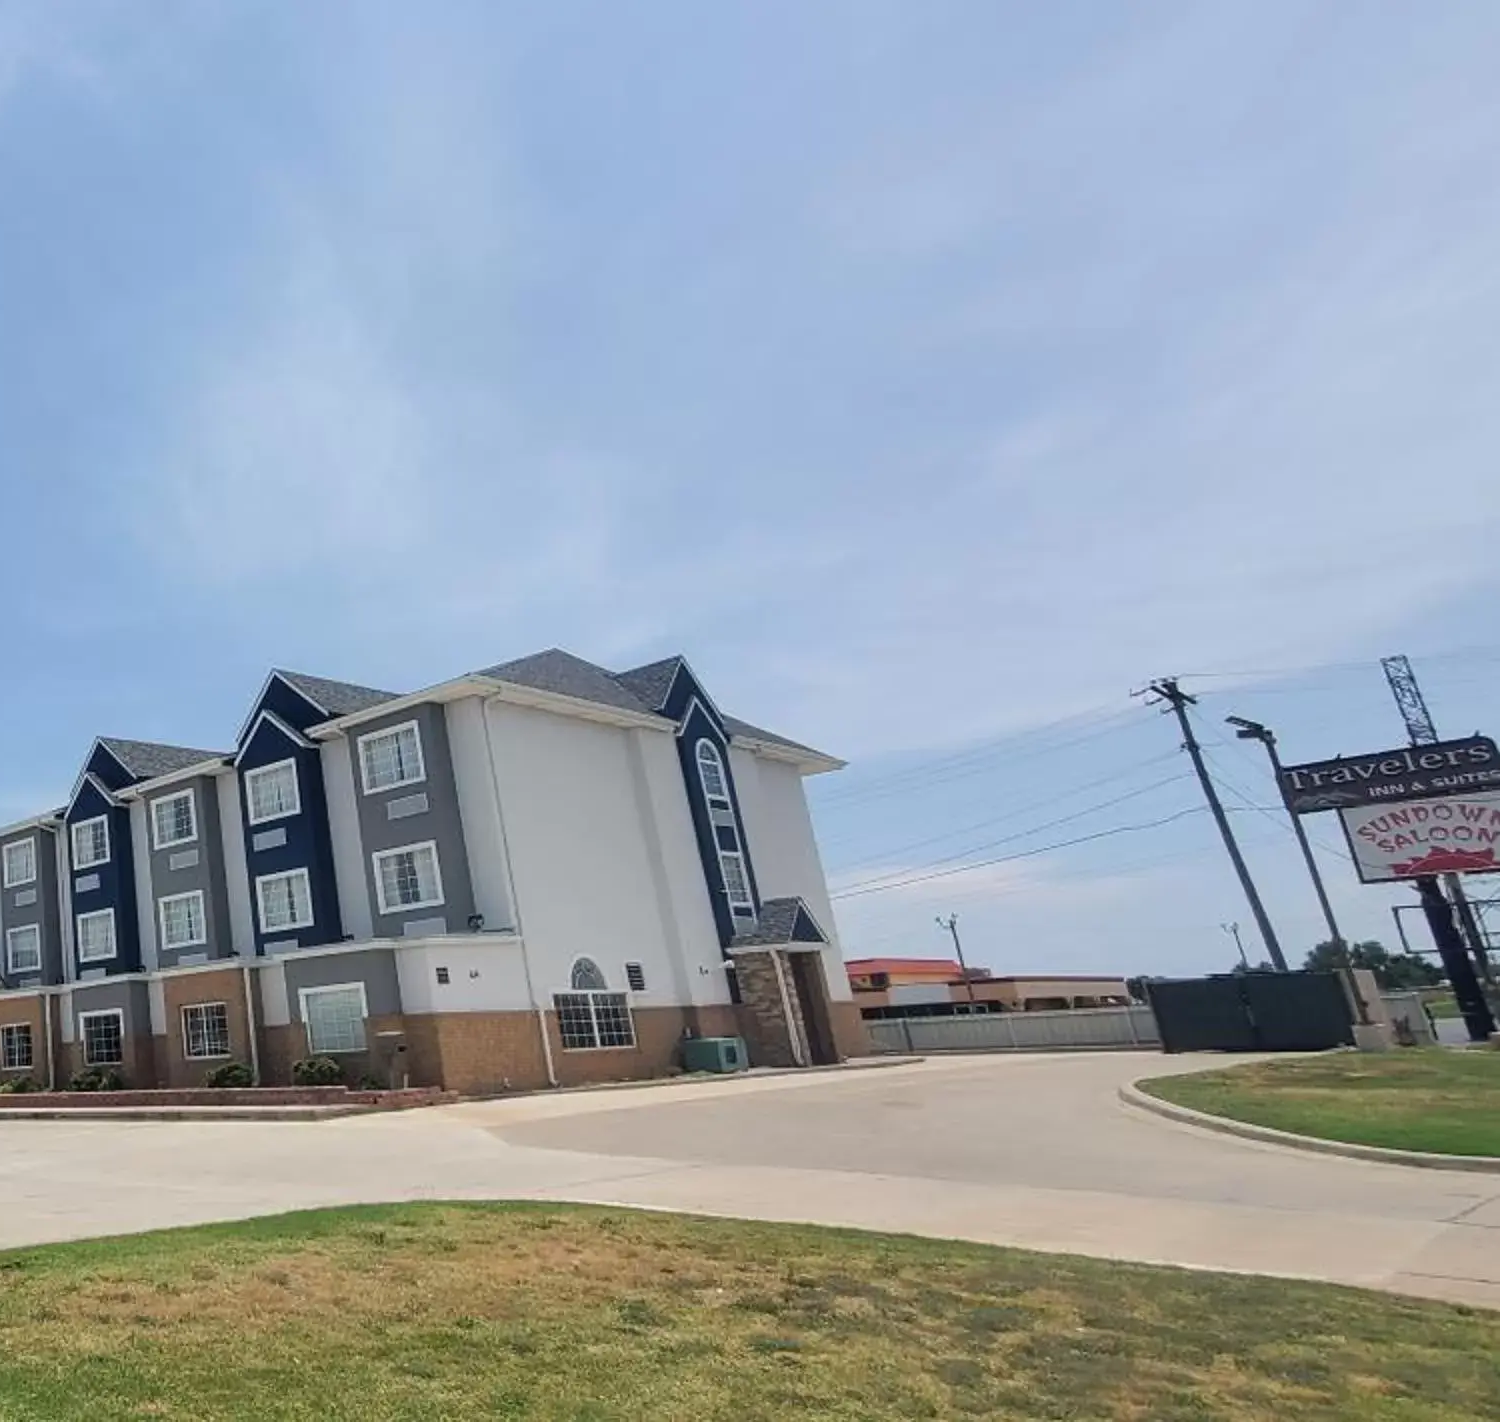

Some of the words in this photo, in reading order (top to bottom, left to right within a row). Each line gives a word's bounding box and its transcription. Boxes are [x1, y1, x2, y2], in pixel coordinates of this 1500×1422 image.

[1285, 744, 1491, 790] Travelers
[1368, 784, 1406, 798] INN
[1376, 825, 1500, 853] SALOON
